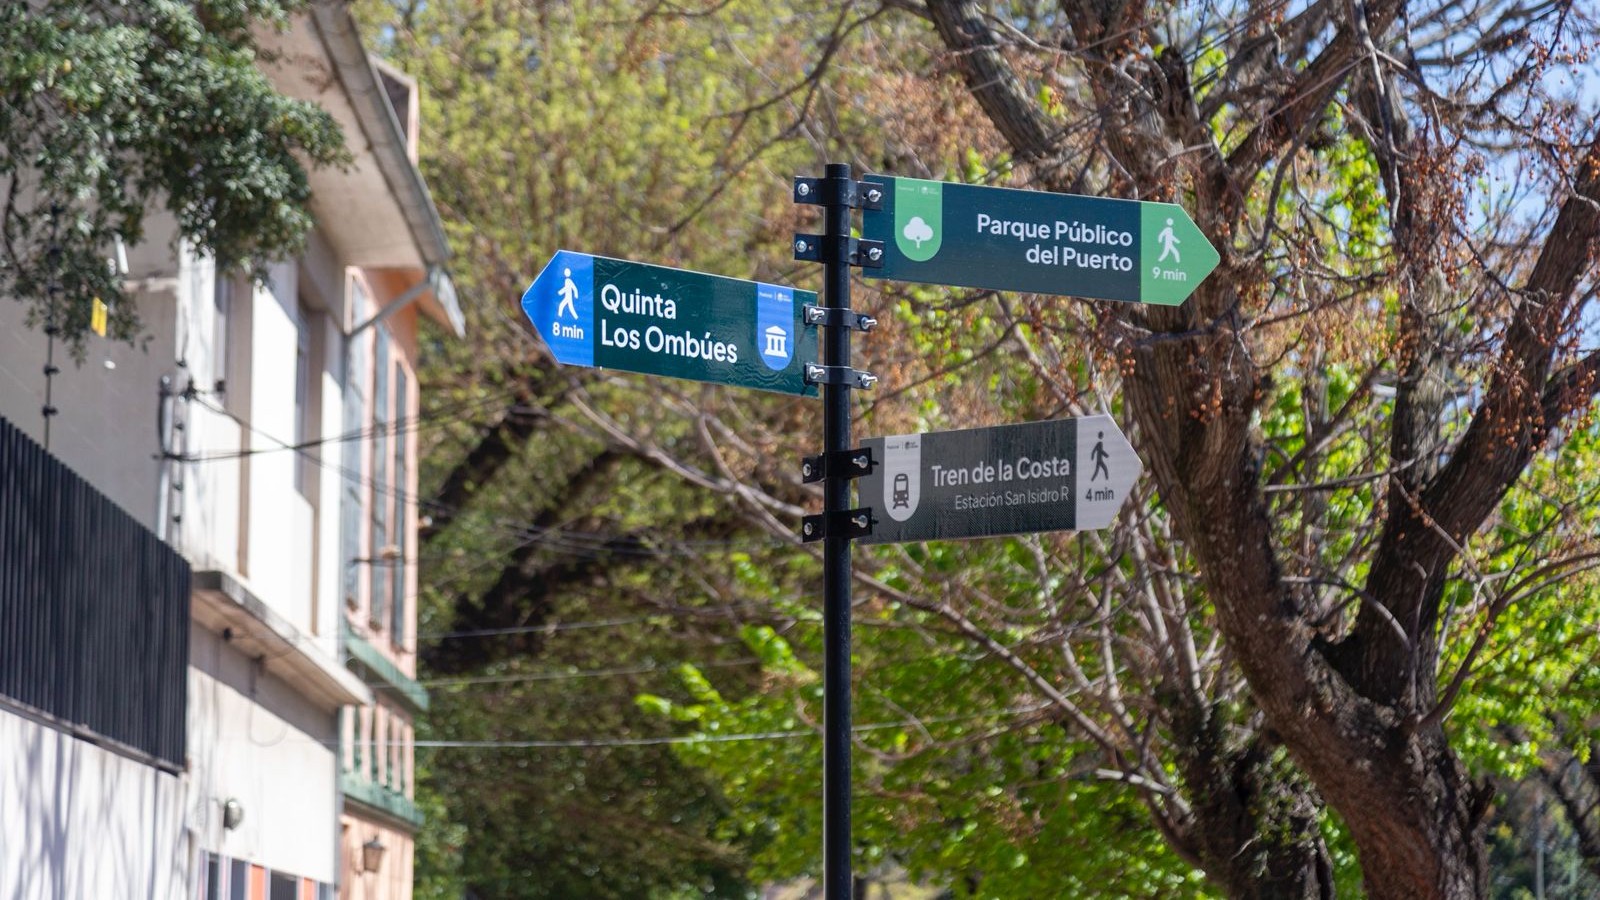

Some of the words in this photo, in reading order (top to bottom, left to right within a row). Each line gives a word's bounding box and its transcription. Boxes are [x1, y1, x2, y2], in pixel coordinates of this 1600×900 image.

[977, 214, 1050, 243] Parque
[1055, 220, 1132, 246] Público
[1026, 244, 1058, 265] del
[1063, 247, 1132, 272] Puerto
[1152, 266, 1161, 280] 9
[1163, 267, 1186, 281] min
[601, 284, 676, 320] Quinta
[552, 322, 560, 336] 8
[562, 323, 584, 339] min
[602, 319, 640, 350] Los
[645, 326, 738, 364] Ombúes
[932, 465, 968, 486] Tren
[972, 461, 994, 484] de
[998, 459, 1012, 481] la
[1016, 457, 1070, 480] Costa
[954, 490, 1003, 510] Estación
[1006, 490, 1026, 506] San
[1028, 488, 1058, 505] Isidro
[1062, 486, 1068, 500] R
[1086, 490, 1092, 501] 4
[1094, 486, 1114, 501] min
